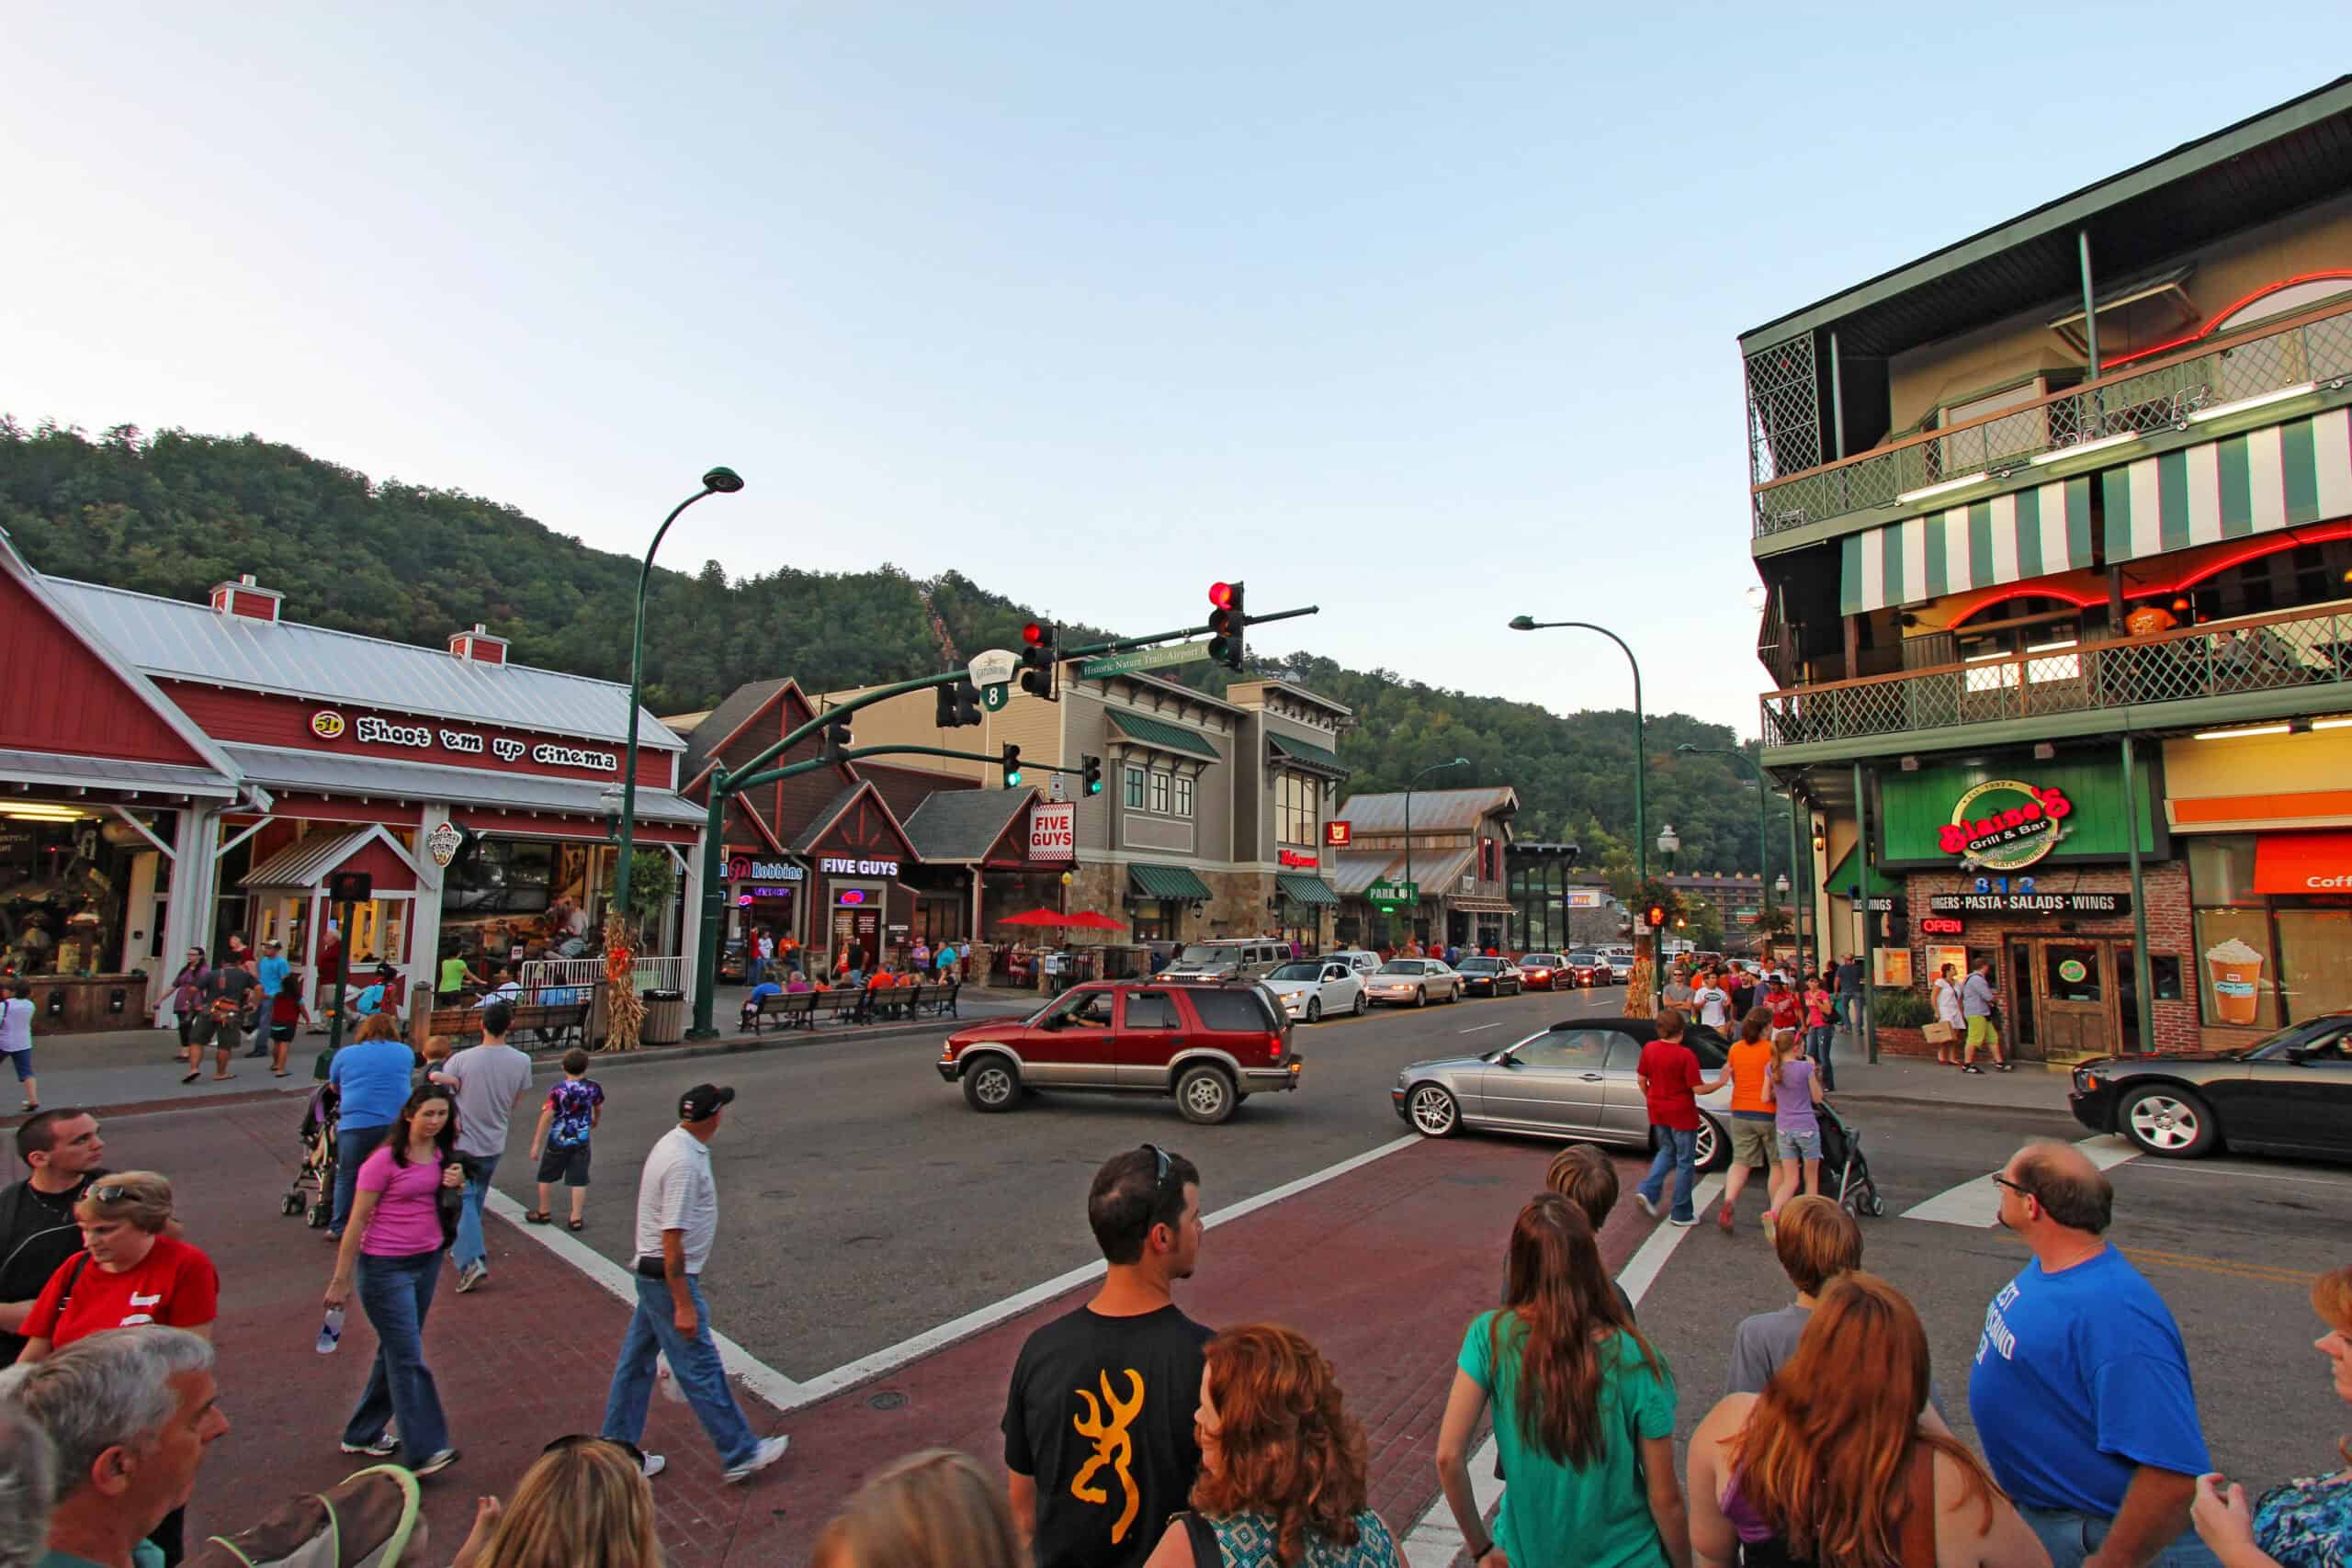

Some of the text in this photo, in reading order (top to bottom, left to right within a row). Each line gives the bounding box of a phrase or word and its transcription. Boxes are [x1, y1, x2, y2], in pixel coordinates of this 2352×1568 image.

[1084, 662, 1113, 676] Historic
[1115, 658, 1142, 671] Nature
[989, 687, 999, 705] 8
[357, 716, 432, 747] Shoot
[493, 738, 525, 761] up
[1035, 817, 1069, 830] FIVE
[1032, 832, 1072, 846] GUYS
[1969, 834, 2001, 851] Grill
[2004, 829, 2017, 840] &
[2018, 819, 2048, 835] Bar
[752, 862, 803, 880] Robbins
[820, 858, 898, 876] FIVE GUYS
[1965, 896, 2002, 909] PASTA
[2009, 896, 2064, 909] SALADS
[2072, 896, 2115, 909] WINGS
[1923, 919, 1962, 932] OPEN
